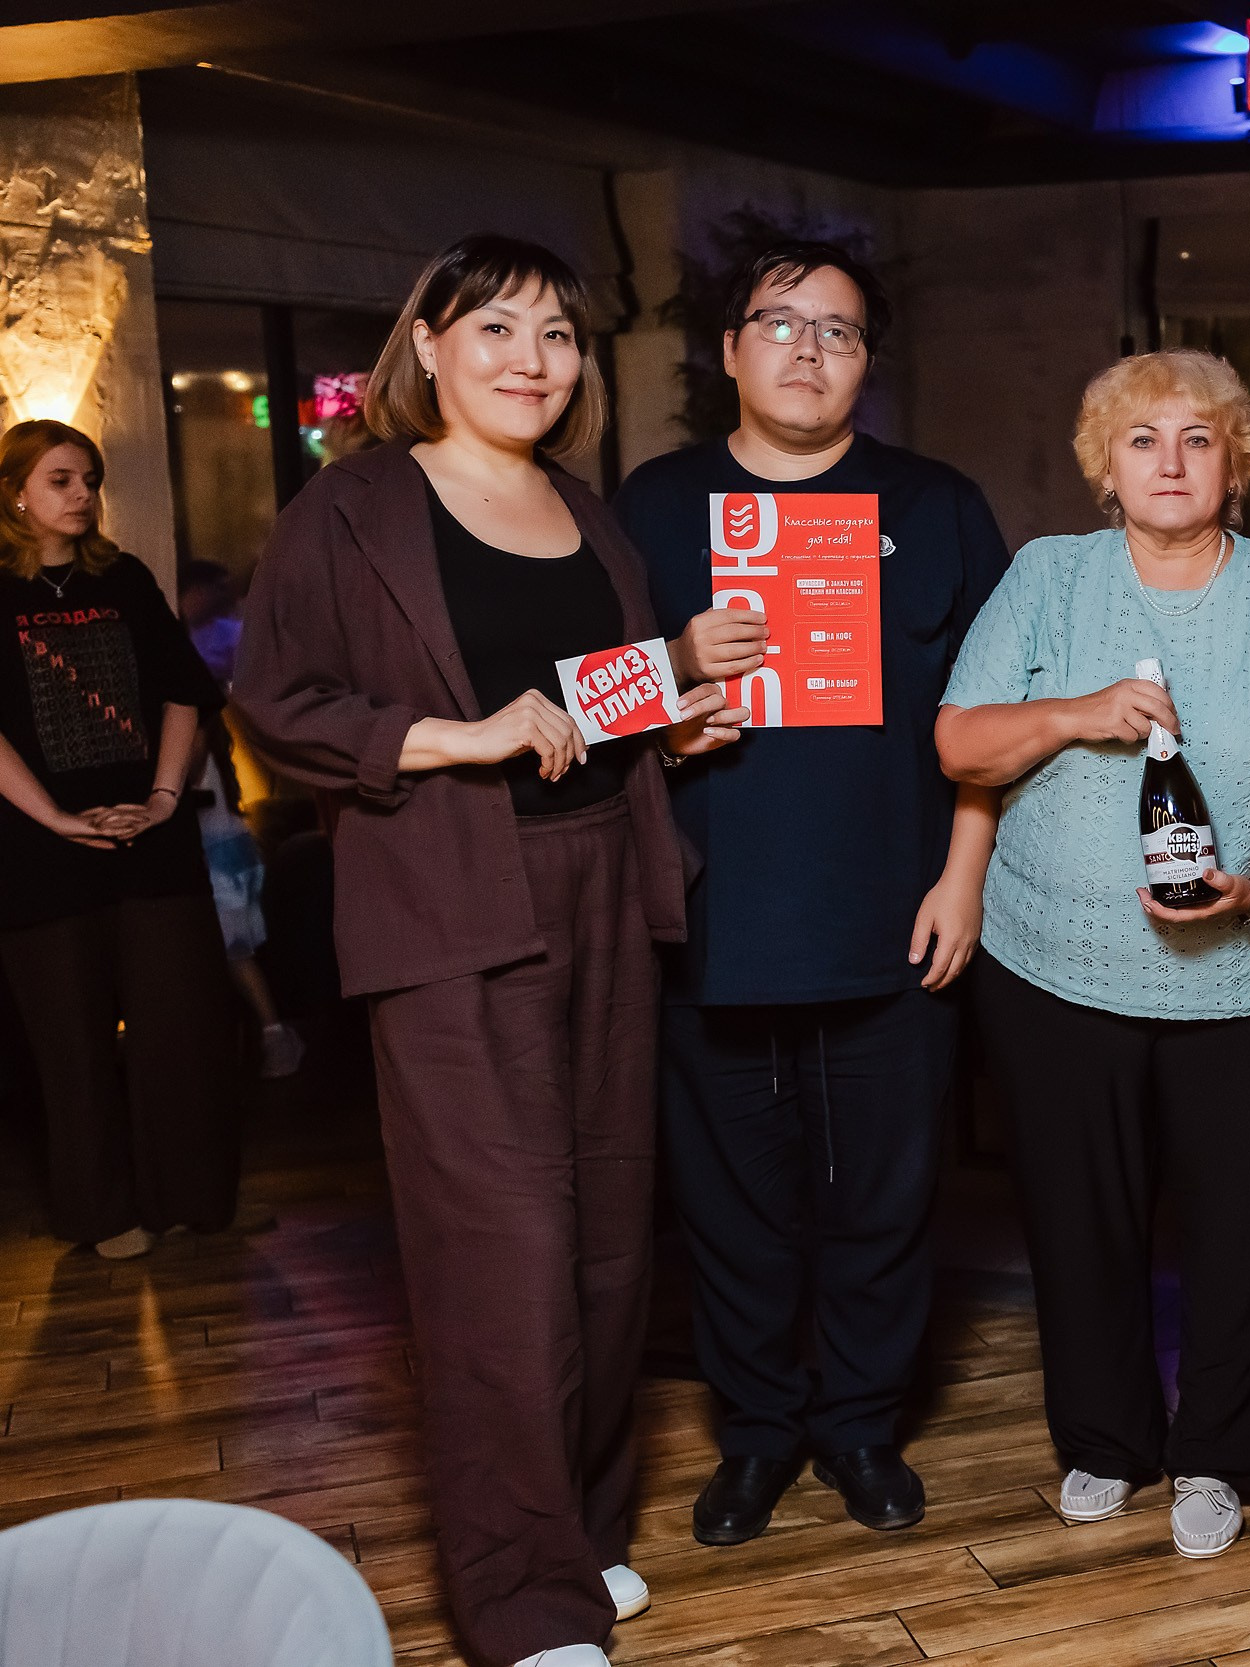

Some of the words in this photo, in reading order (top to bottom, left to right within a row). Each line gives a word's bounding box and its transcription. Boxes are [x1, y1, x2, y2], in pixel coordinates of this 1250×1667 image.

[784, 515, 832, 527] Классные
[835, 518, 874, 531] подарки
[805, 535, 823, 550] для
[827, 533, 852, 545] тебя!
[16, 614, 29, 627] Я
[836, 632, 852, 641] КОФЕ
[575, 649, 655, 705] КВИЗ,
[826, 680, 835, 688] НА
[836, 679, 858, 688] ВЫБОР
[585, 669, 663, 728] ПЛИЗ!
